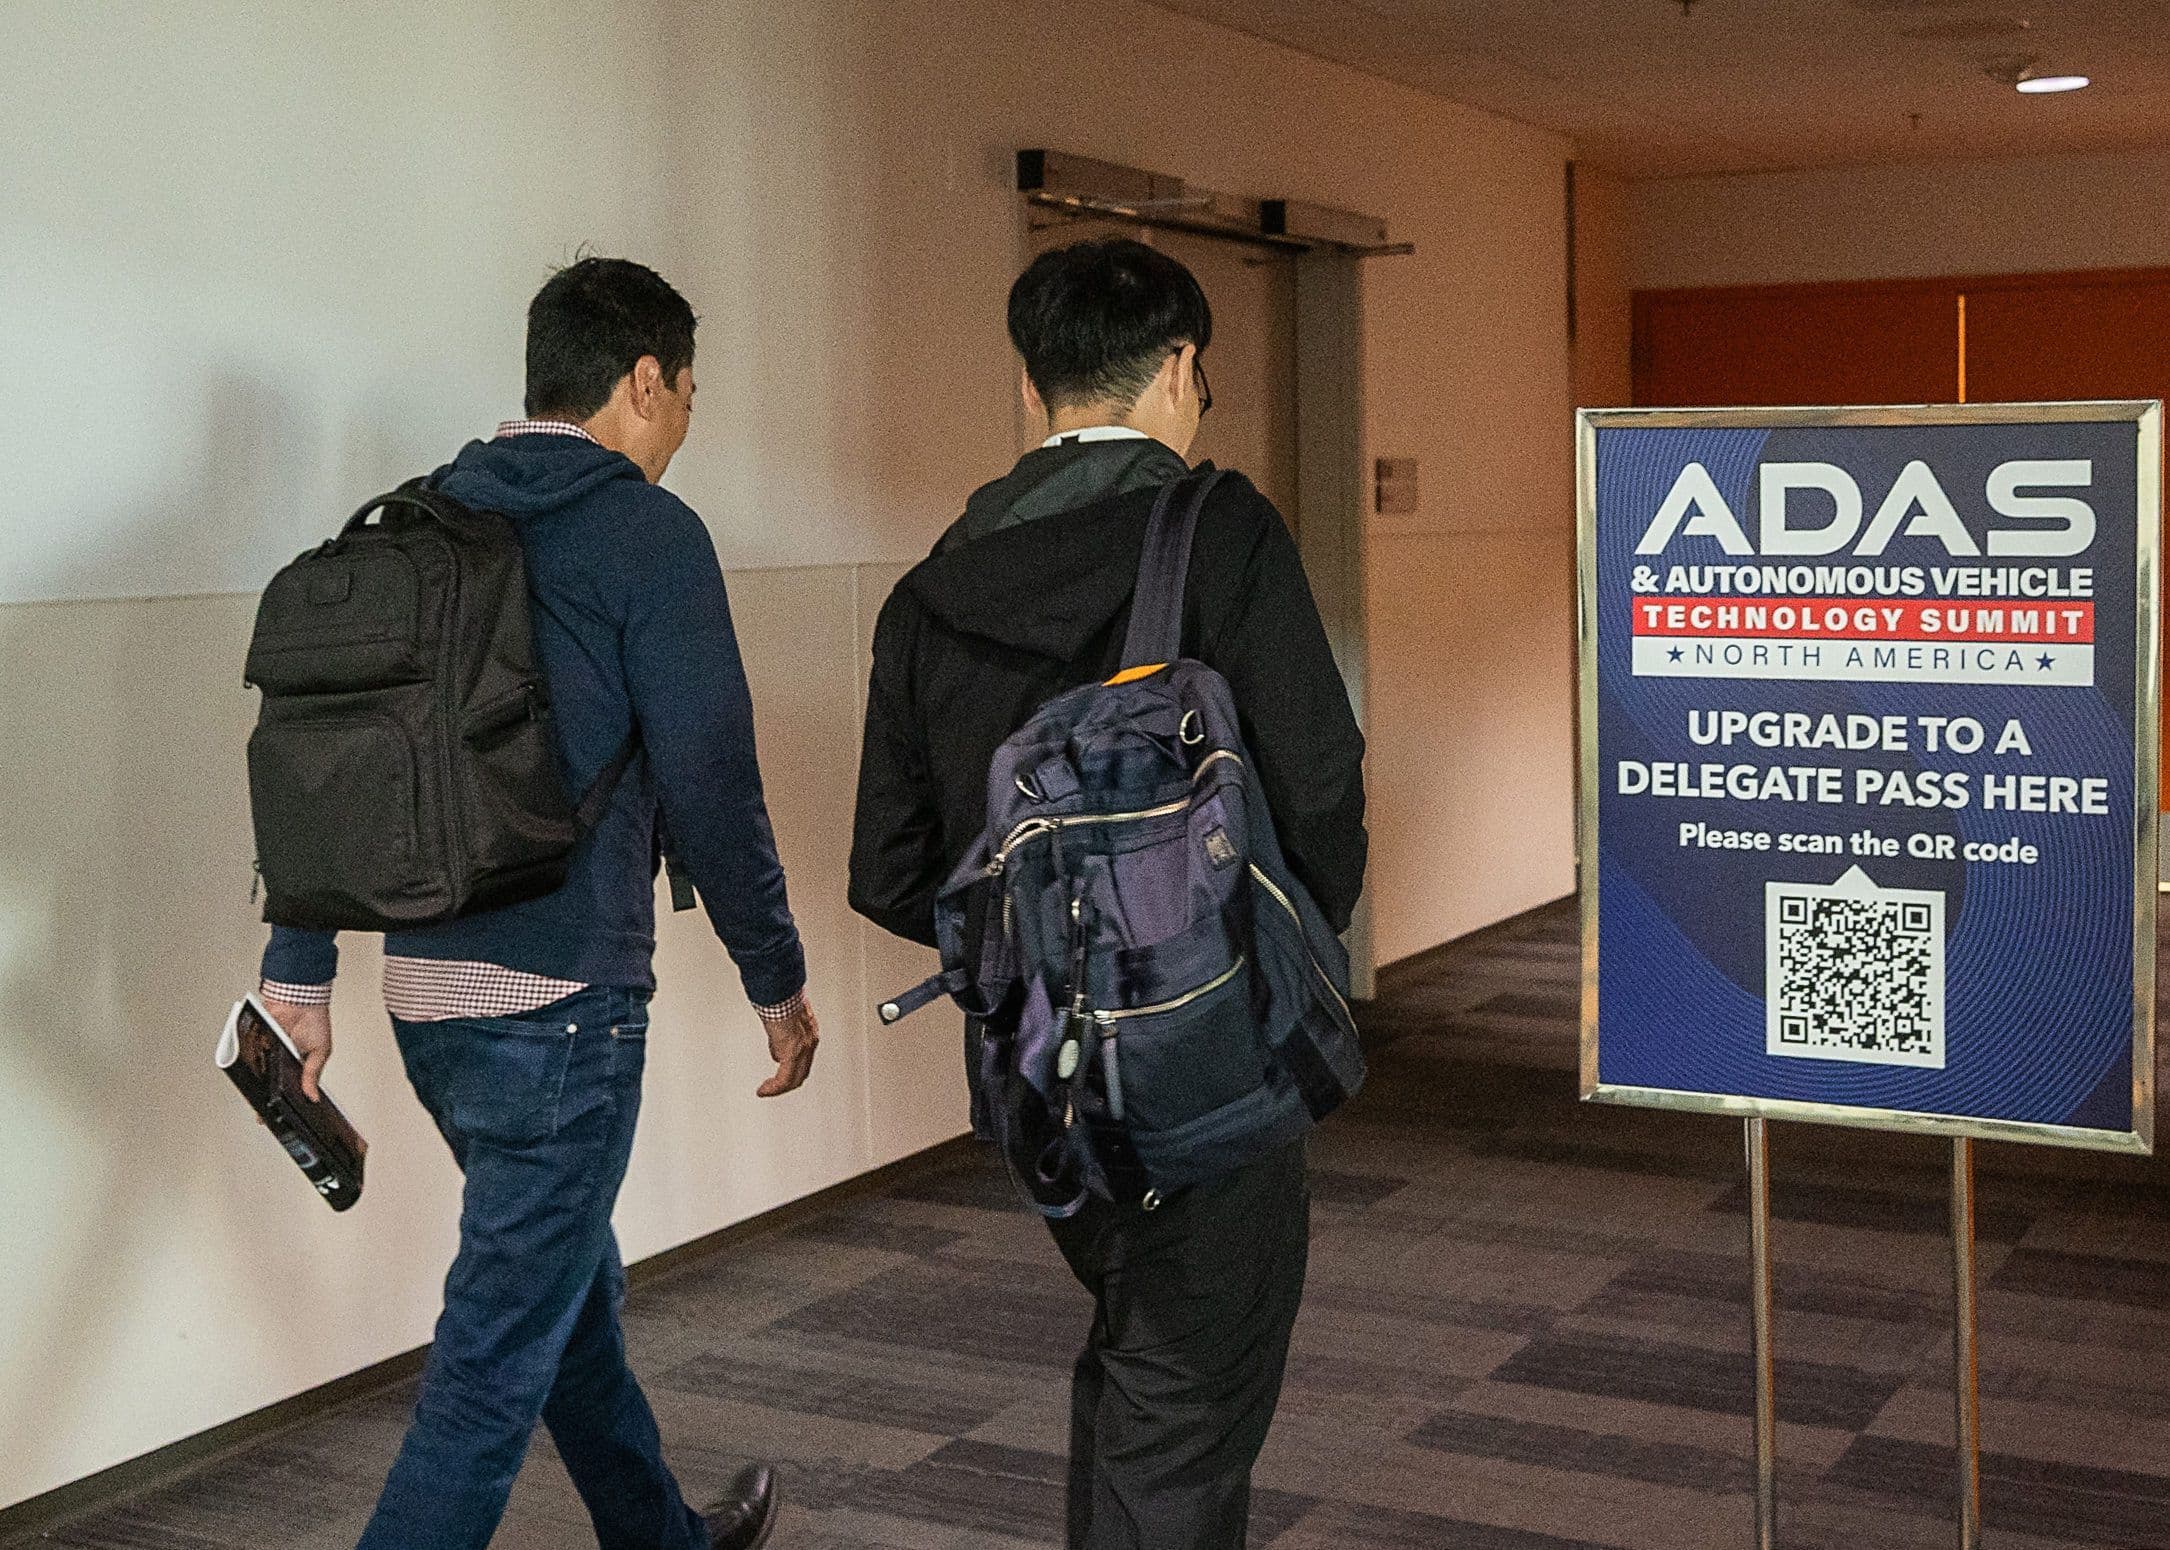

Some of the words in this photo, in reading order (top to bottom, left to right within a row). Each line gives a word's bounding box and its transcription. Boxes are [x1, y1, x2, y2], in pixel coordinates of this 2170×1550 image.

[1633, 459, 2097, 557] ADAS
[1629, 564, 1660, 593] &
[1664, 565, 1926, 596] AUTONOMOUS
[1929, 567, 2094, 597] VEHICLE
[1641, 604, 1904, 632] TECHNOLOGY
[1920, 608, 2084, 635] SUMMIT
[1696, 643, 1821, 667] NORTH
[1845, 646, 2024, 672] AMERICA
[1688, 709, 1909, 751] UPGRADE
[1917, 716, 1985, 754] TO
[1994, 719, 2033, 756] A
[1618, 760, 1843, 801] DELEGATE
[1856, 769, 1970, 809] PASS
[1983, 774, 2109, 815] HERE
[1679, 822, 1772, 851] Please
[1777, 833, 1843, 854] scan
[1849, 829, 1900, 857] the
[1907, 833, 1956, 860] QR
[1963, 836, 2039, 864] code
